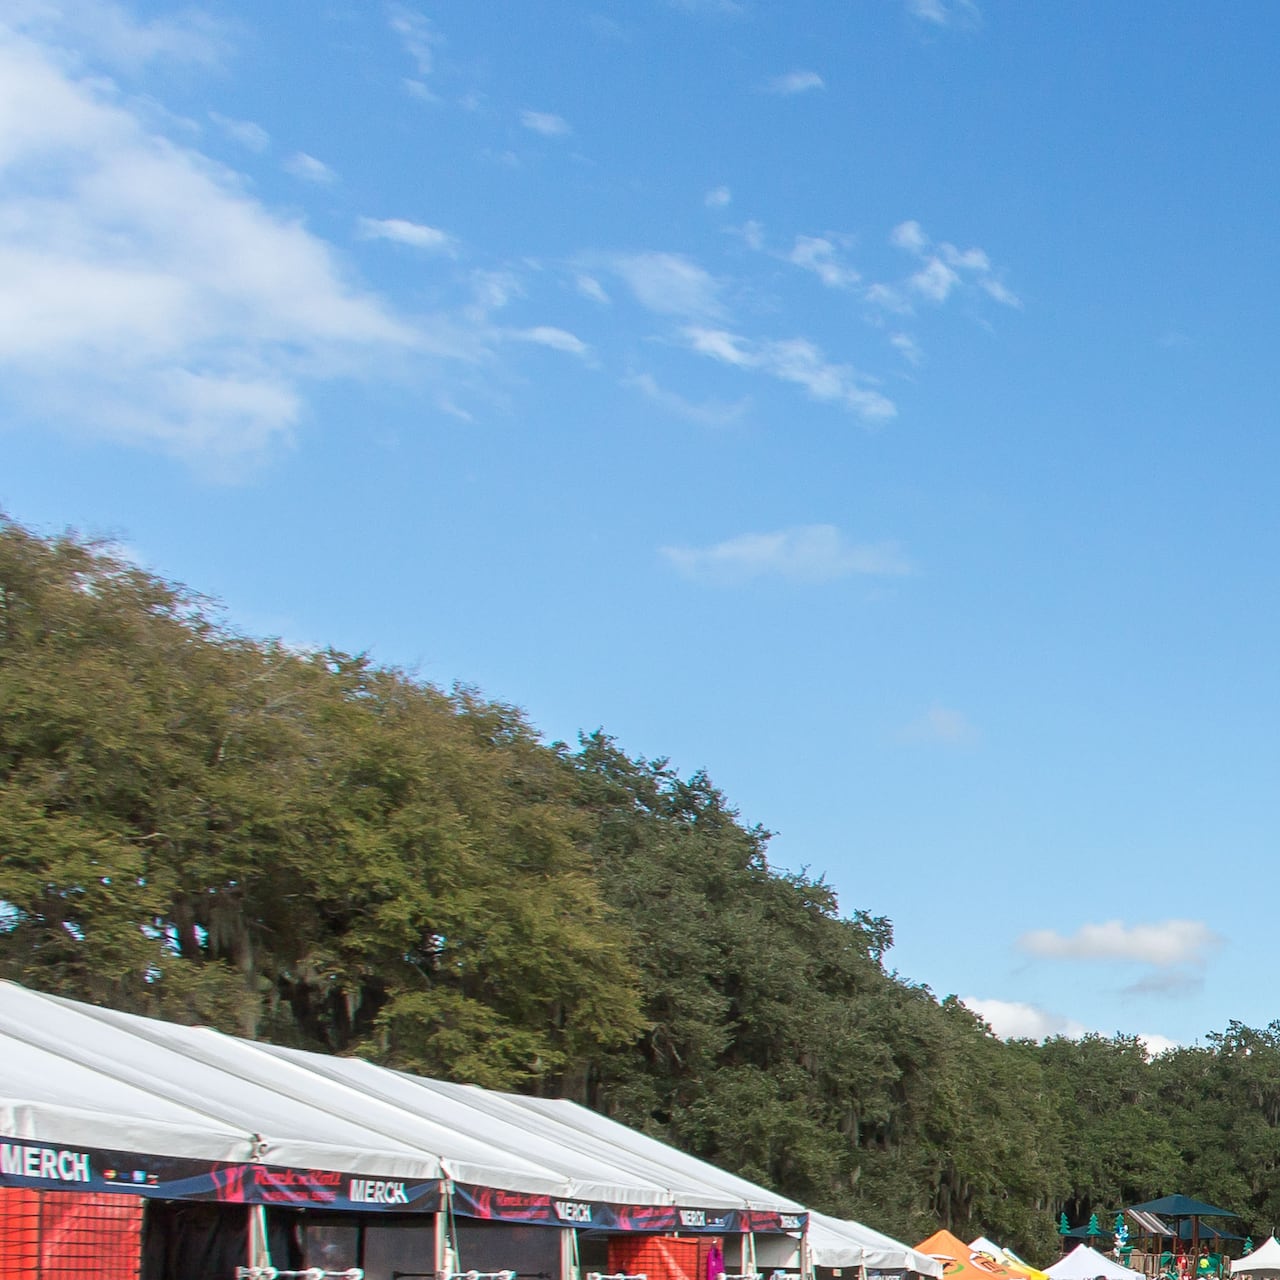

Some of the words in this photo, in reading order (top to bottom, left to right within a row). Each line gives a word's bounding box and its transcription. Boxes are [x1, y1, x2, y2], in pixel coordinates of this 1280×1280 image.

[1, 1143, 90, 1182] MERCH
[351, 1178, 410, 1204] MERCH
[555, 1200, 593, 1222] MERCH
